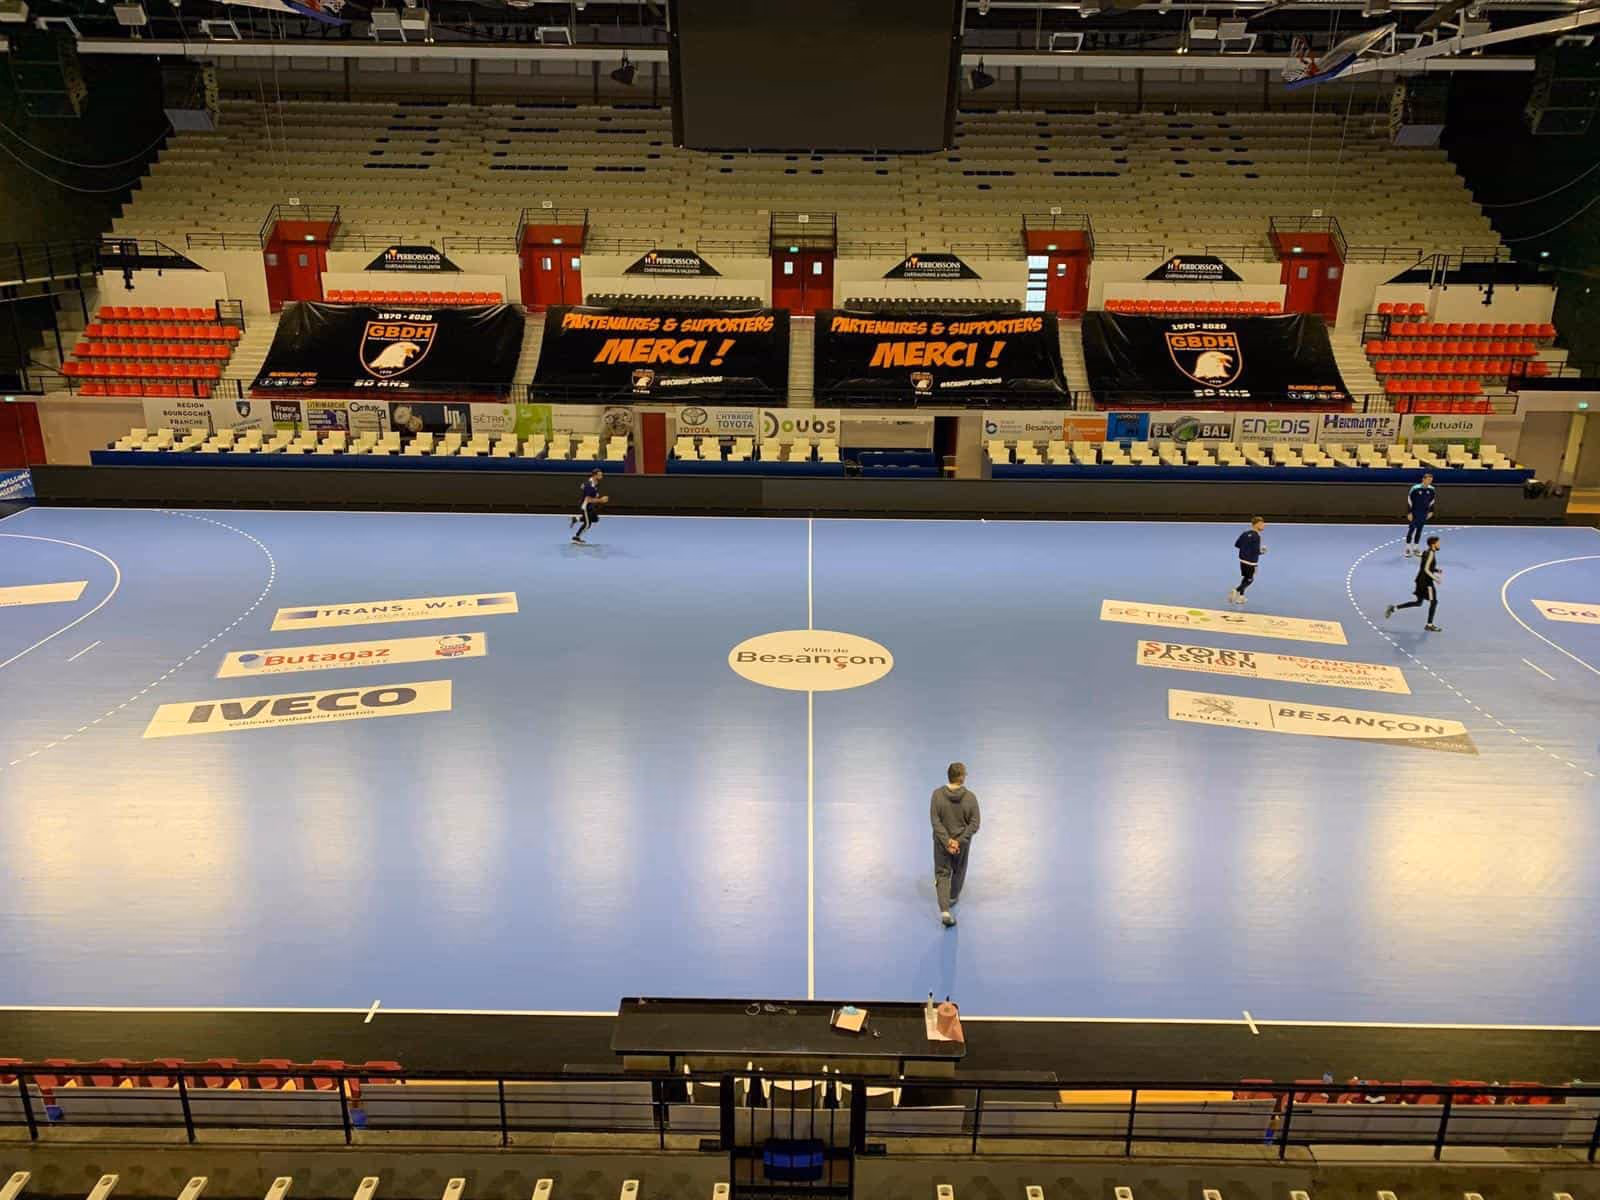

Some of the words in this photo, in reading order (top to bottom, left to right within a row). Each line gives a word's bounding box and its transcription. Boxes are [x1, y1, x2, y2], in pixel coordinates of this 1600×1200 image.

[368, 325, 433, 338] GBDH
[561, 312, 660, 331] PARTENAIRES
[662, 317, 679, 331] &
[680, 315, 775, 333] SUPPORTERS
[830, 316, 928, 335] PARTENAIRES
[930, 320, 945, 335] &
[948, 316, 1043, 335] SUPPORTERS
[593, 338, 708, 365] MERCI
[1170, 335, 1235, 348] GBDH
[869, 340, 978, 369] MERCI
[717, 420, 754, 428] TOYOTA
[263, 648, 391, 667] Butagaz
[736, 651, 887, 671] Besançon
[1143, 650, 1257, 669] PASSION
[1144, 641, 1254, 662] SPORT
[186, 687, 418, 724] IVECO
[1278, 707, 1446, 735] BESANÇON
